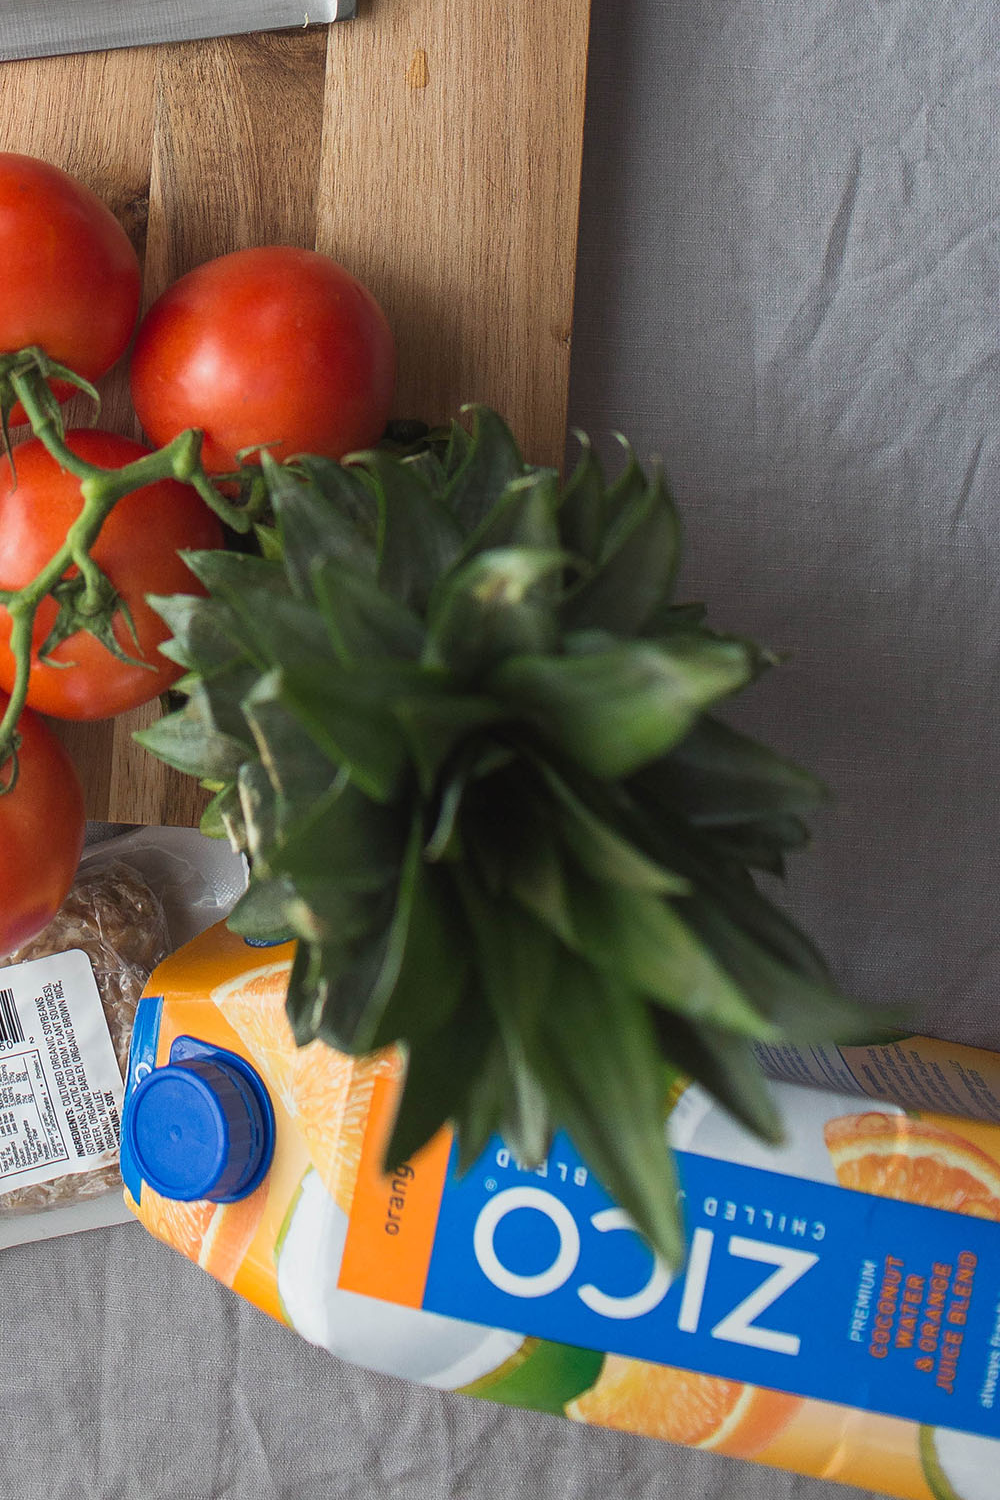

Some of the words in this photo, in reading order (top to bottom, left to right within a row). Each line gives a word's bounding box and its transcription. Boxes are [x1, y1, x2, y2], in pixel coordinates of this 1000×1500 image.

[42, 983, 59, 1020] SOURCES),
[52, 980, 64, 999] RICE,
[35, 997, 52, 1035] SOYBEANS
[58, 1000, 72, 1028] BROWN
[29, 1036, 35, 1044] 2
[52, 1022, 65, 1046] PLANT
[65, 1029, 81, 1062] ORGANIC
[45, 1036, 61, 1070] ORGANIC
[59, 1046, 72, 1068] FROM
[54, 1071, 71, 1106] CULTURED
[64, 1069, 76, 1086] ACID
[74, 1062, 89, 1091] BARLEY,
[69, 1086, 84, 1112] LACTIC
[82, 1092, 98, 1124] ORGANIC
[92, 1090, 106, 1116] MILLET.
[103, 1091, 113, 1106] SOY.
[65, 1108, 85, 1157] INGREDIENTS:
[77, 1112, 96, 1155] (SOYBEANS,
[92, 1125, 106, 1153] WATER,
[100, 1117, 115, 1149] ORGANIC
[384, 1164, 415, 1236] orang
[703, 1197, 826, 1241] CHILLED
[473, 1186, 820, 1356] ZICO
[851, 1260, 877, 1342] PREMIUM
[948, 1251, 977, 1325] BLEND
[870, 1254, 903, 1358] COCONUT
[896, 1274, 925, 1348] WATER
[919, 1262, 952, 1352] ORANGE
[915, 1356, 935, 1372] &
[936, 1330, 963, 1394] JUICE
